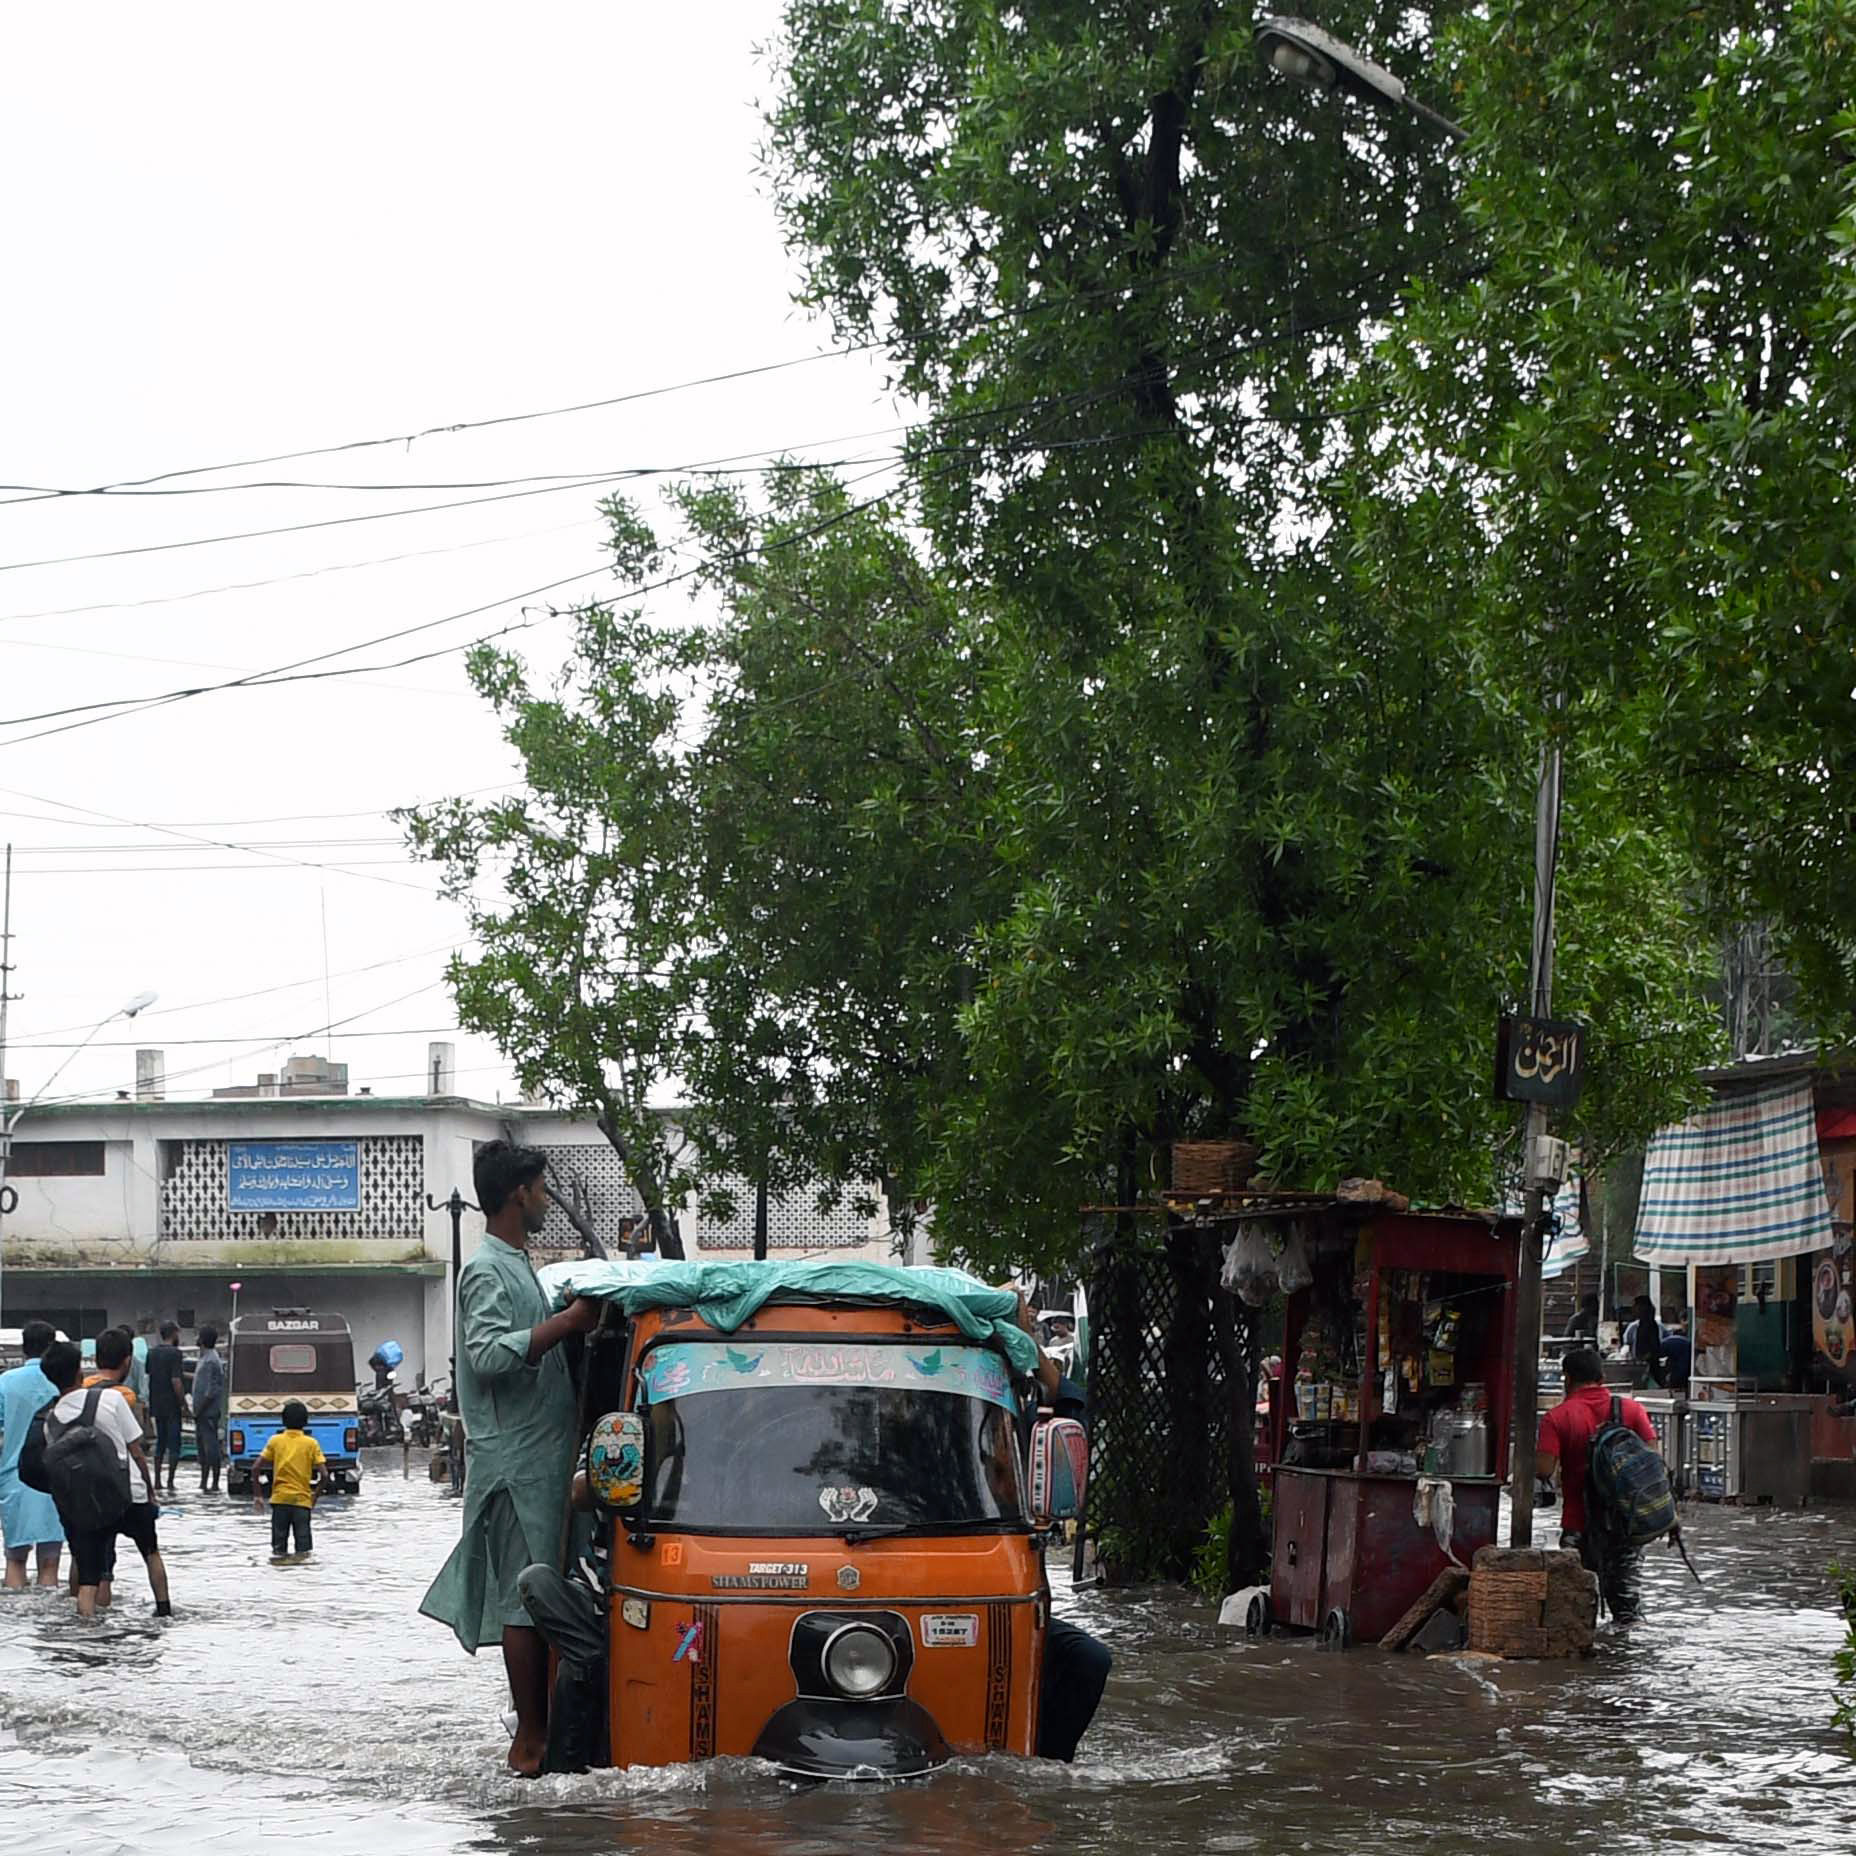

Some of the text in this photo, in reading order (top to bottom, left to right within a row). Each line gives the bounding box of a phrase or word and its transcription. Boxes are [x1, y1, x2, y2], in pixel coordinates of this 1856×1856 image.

[711, 1575, 809, 1589] SHAMS POWER
[695, 1666, 711, 1757] SHAMS
